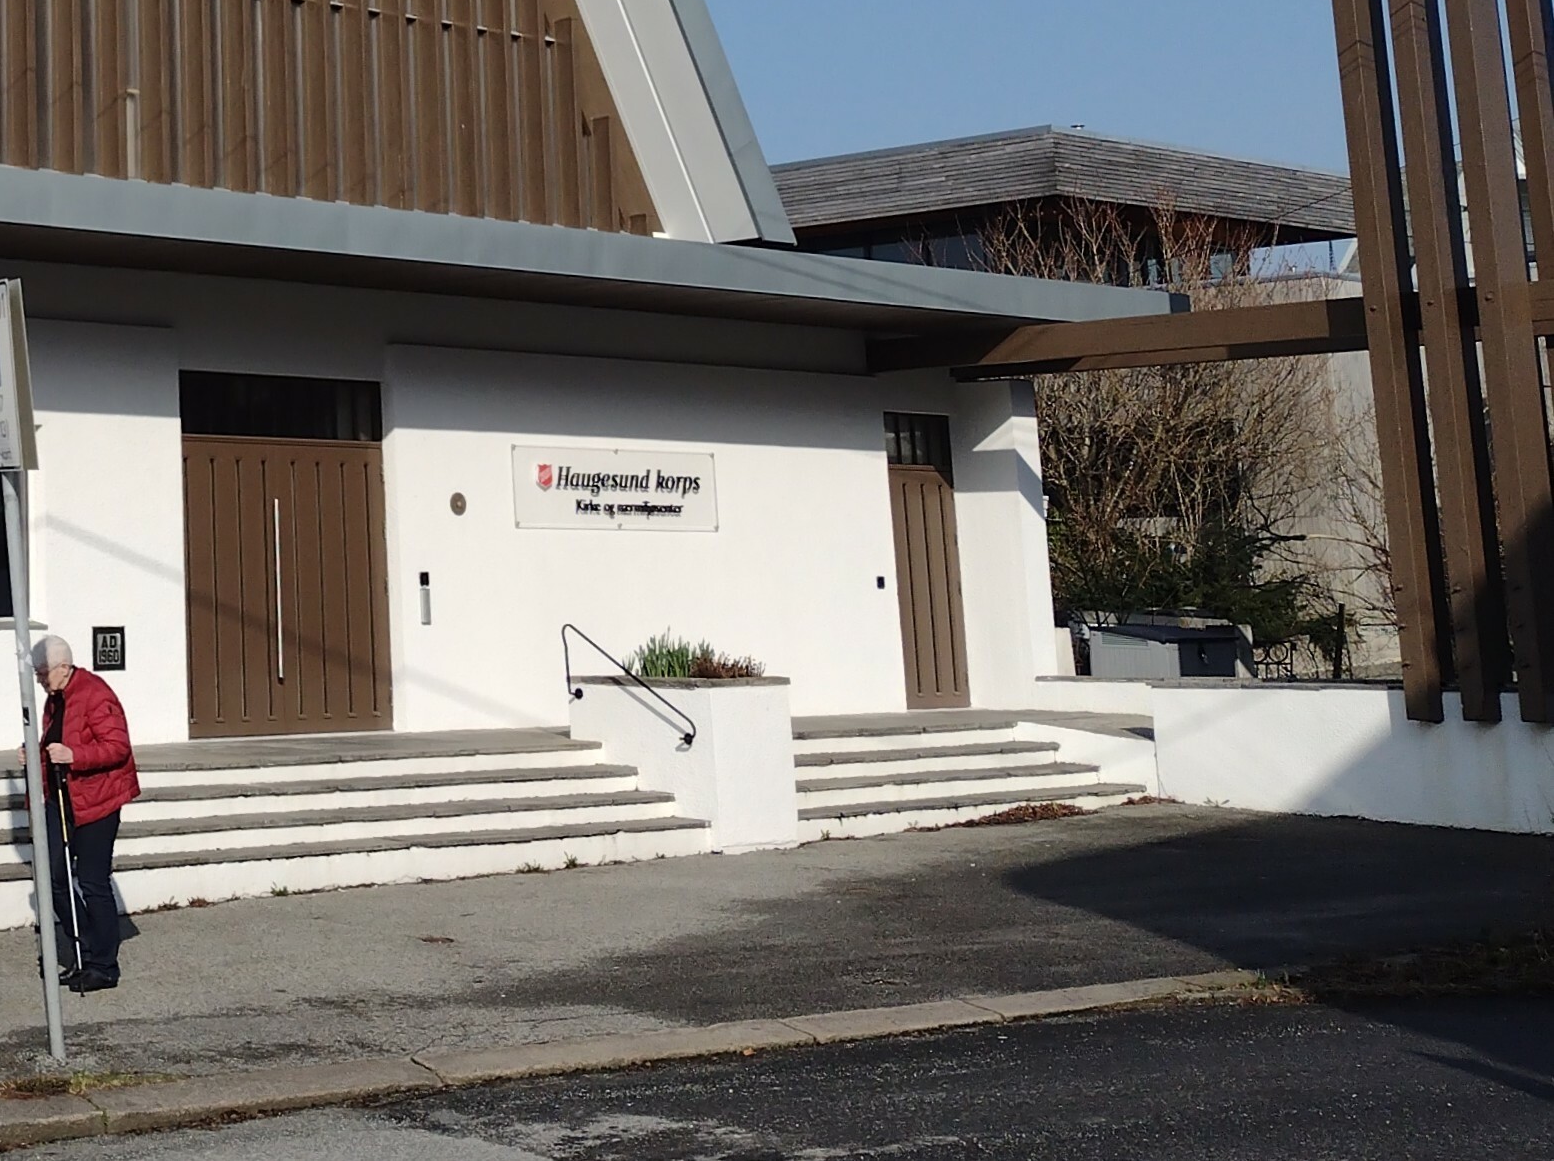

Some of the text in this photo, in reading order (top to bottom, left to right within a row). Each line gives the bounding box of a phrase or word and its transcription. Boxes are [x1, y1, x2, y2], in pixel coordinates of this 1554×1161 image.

[557, 466, 650, 495] Haugesund
[656, 470, 701, 498] korps
[576, 499, 601, 512] Kirke
[603, 504, 615, 517] og
[101, 635, 117, 648] AD
[99, 649, 119, 663] 1960
